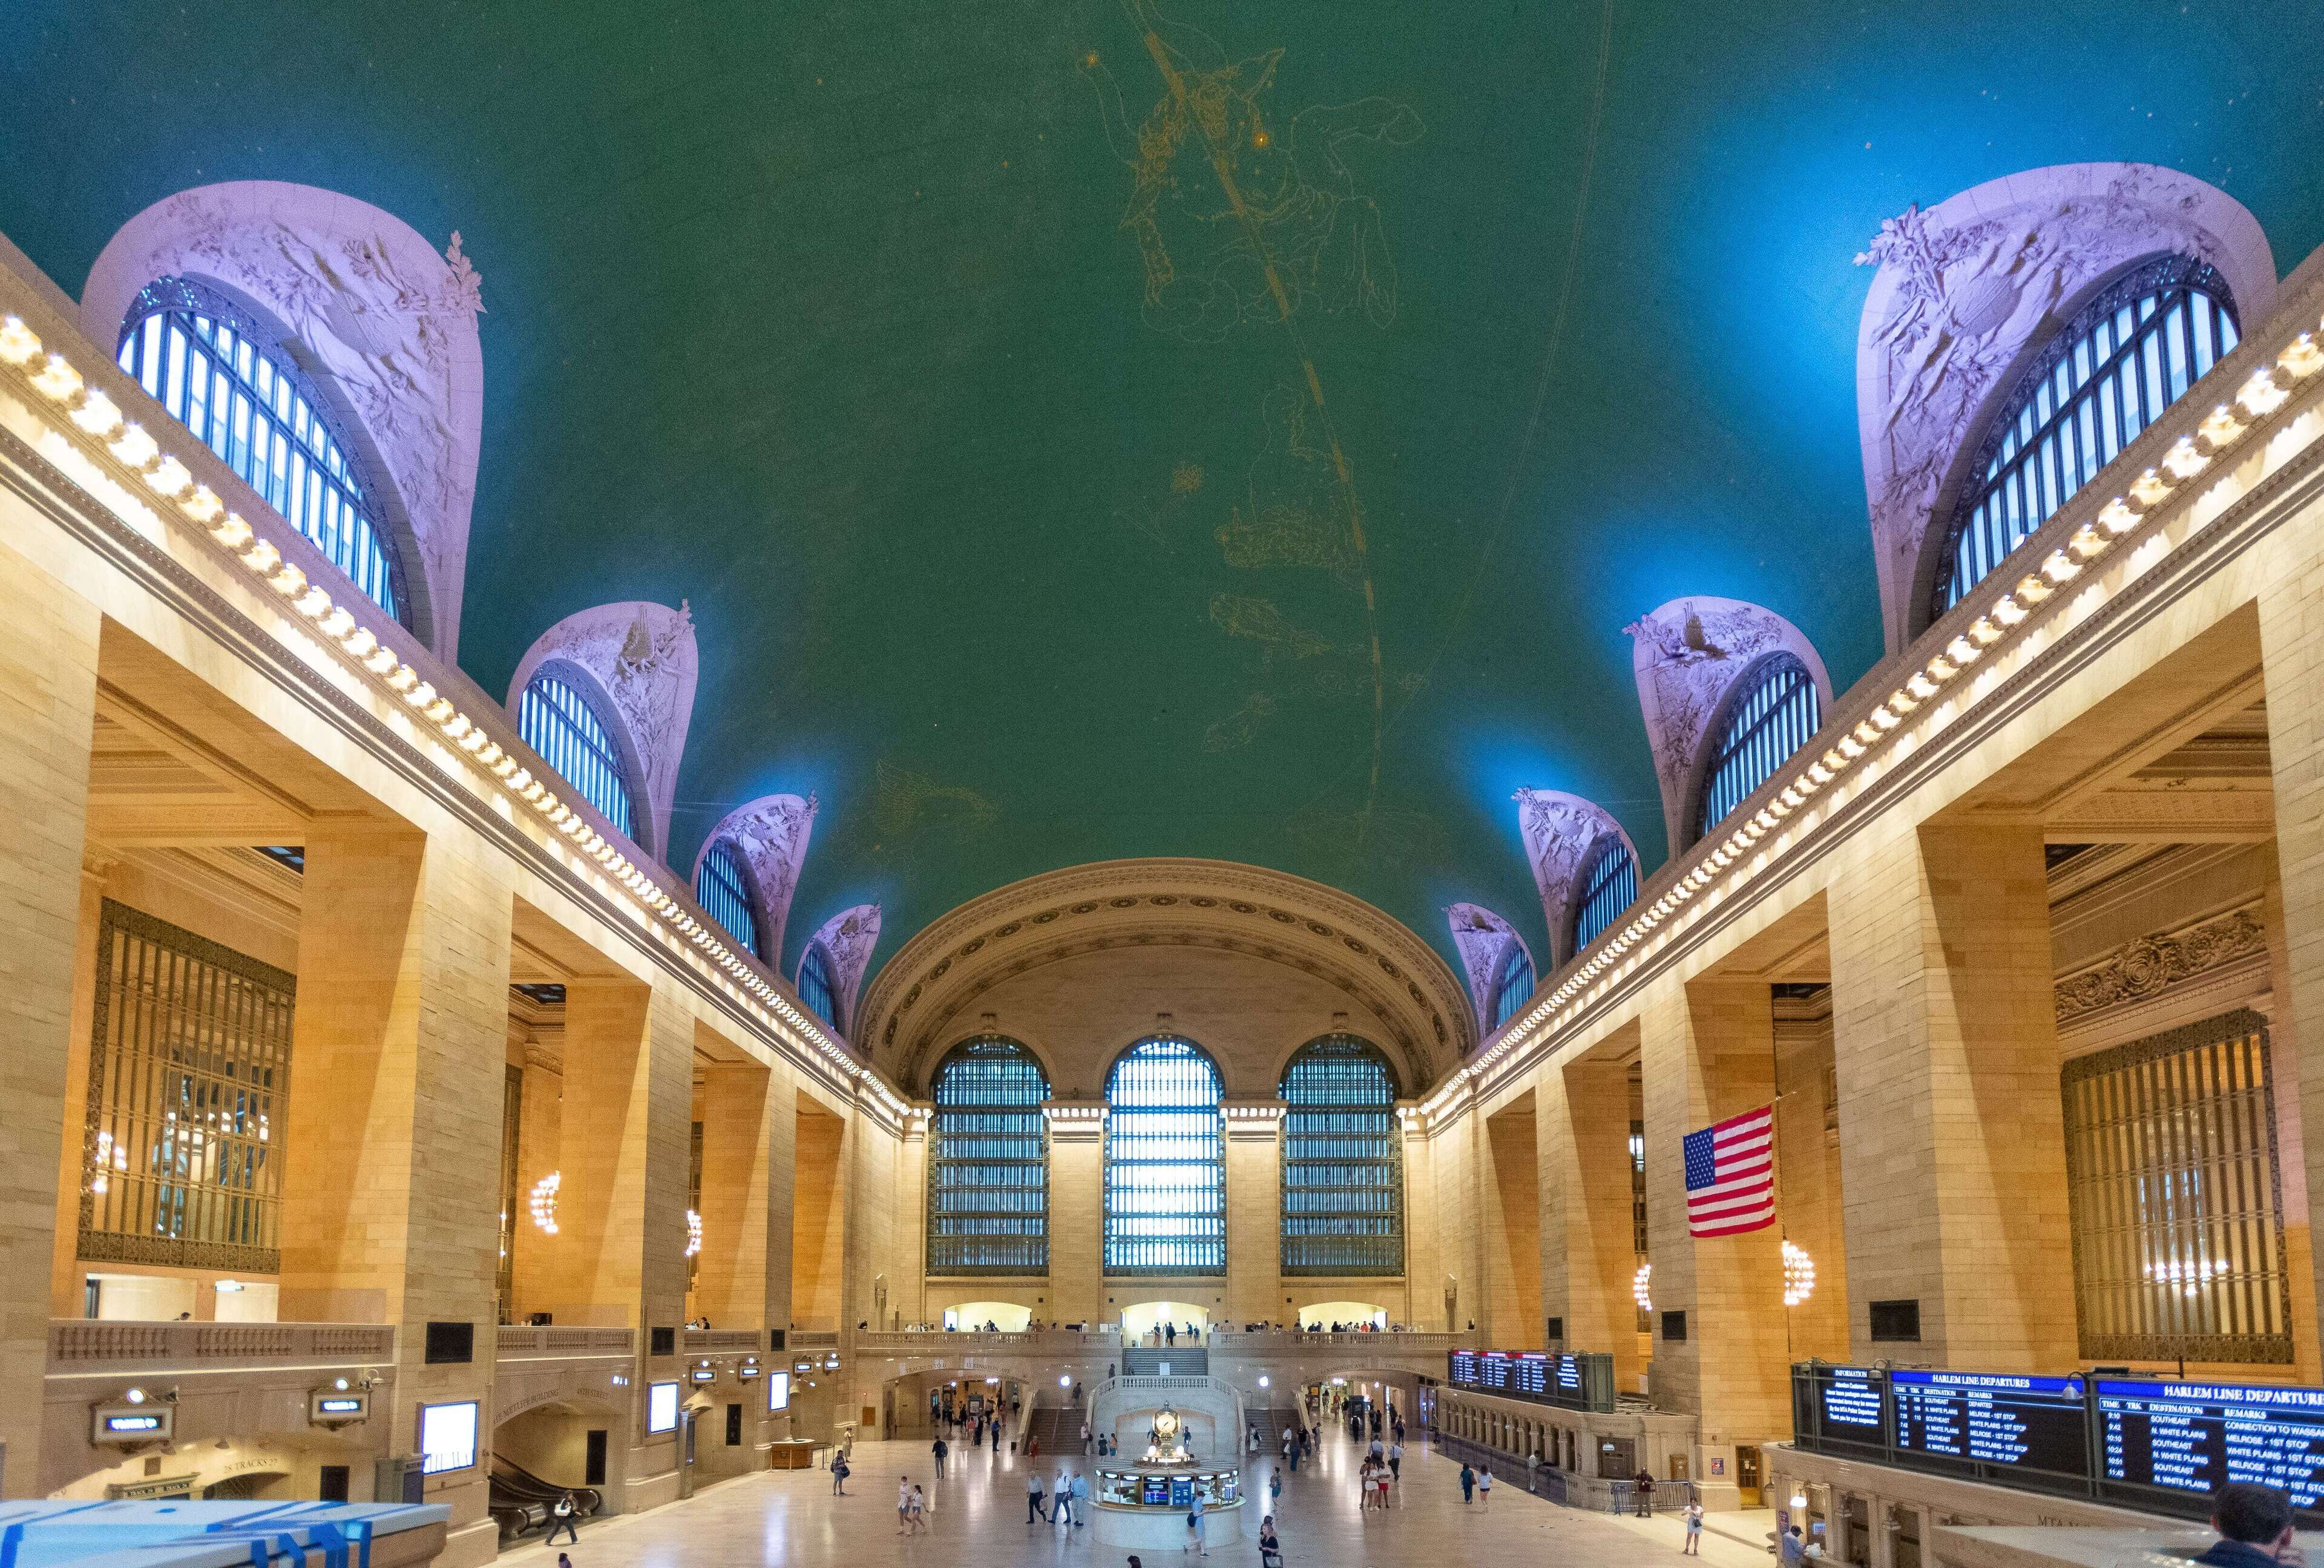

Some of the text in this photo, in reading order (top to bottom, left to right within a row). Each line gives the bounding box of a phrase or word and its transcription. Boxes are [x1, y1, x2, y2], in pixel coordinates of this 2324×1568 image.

[1932, 1374, 2030, 1388] HARLEM LINE DEPARTURES
[2164, 1385, 2212, 1399] HARLEM
[2214, 1388, 2244, 1401] LINE
[1969, 1410, 1991, 1419] MELROSE
[2101, 1400, 2267, 1420] TIME TRK DESTINATION REMARKS
[2150, 1415, 2190, 1425] SOUTHEAST
[2225, 1421, 2276, 1433] CONNECTION
[2277, 1425, 2290, 1434] TO
[1985, 1441, 2001, 1449] PLAINS
[2159, 1428, 2182, 1437] WHITE
[2182, 1430, 2207, 1440] PLAINS
[2226, 1433, 2263, 1445] MELROSE
[2269, 1438, 2284, 1447] 1ST
[2286, 1439, 2309, 1450] STOP
[1945, 1445, 1960, 1454] PLAINS
[1971, 1449, 1992, 1458] MELROSE
[2152, 1438, 2193, 1451] SOUTHEAST
[2227, 1446, 2252, 1457] WHITE
[2253, 1449, 2282, 1461] PLAINS
[2288, 1453, 2303, 1463] 1ST
[235, 1458, 266, 1471] TRACKS
[2161, 1451, 2183, 1461] WHITE
[2183, 1454, 2209, 1465] PLAINS
[2228, 1459, 2266, 1472] MELROSE
[2272, 1465, 2287, 1474] 1ST
[2288, 1466, 2313, 1477] STOP
[2153, 1463, 2194, 1475] SOUTHEAST
[2291, 1480, 2306, 1491] 1ST
[2162, 1476, 2184, 1486] WHITE
[2185, 1478, 2210, 1490] PLAINS
[2290, 1494, 2316, 1505] STOP
